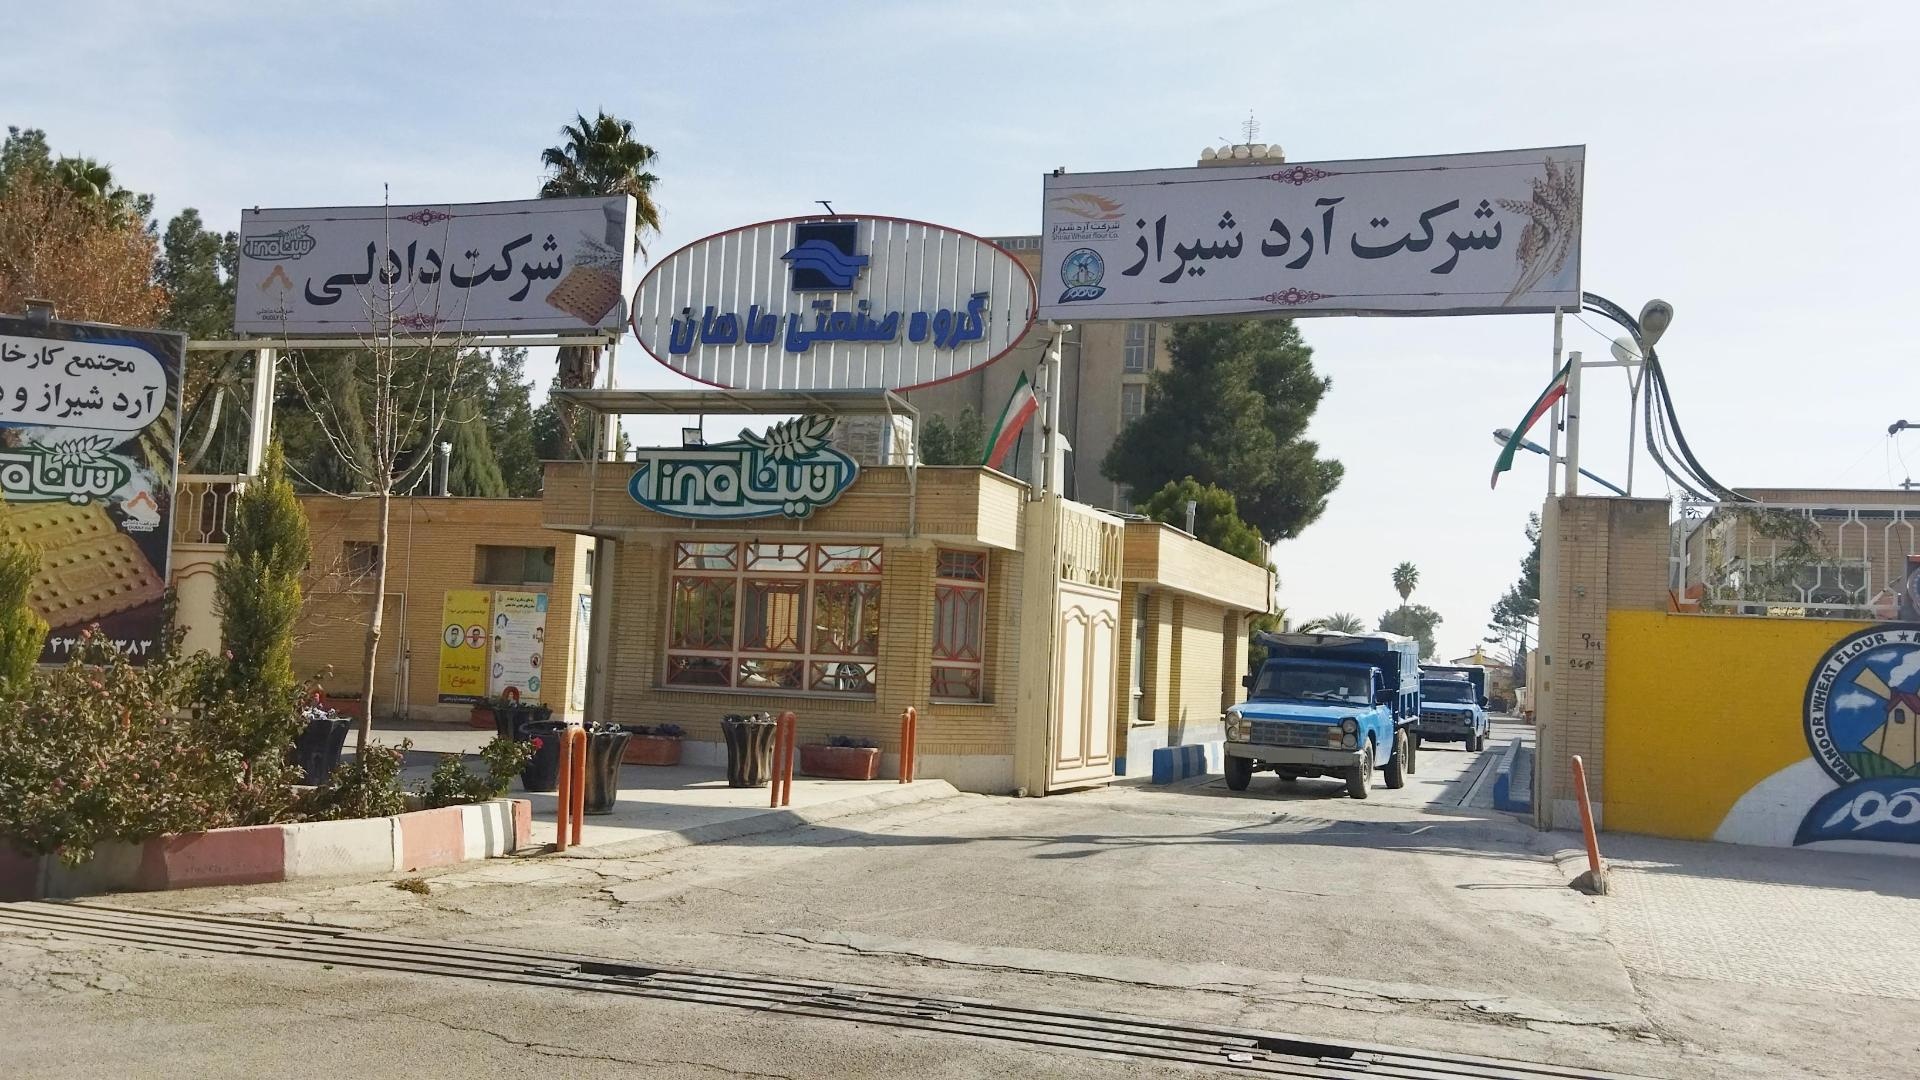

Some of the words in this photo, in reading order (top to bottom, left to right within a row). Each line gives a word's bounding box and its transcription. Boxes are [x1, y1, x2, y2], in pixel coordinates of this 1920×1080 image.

[1053, 224, 1075, 234] شیراز
[1076, 222, 1090, 232] آرد
[1091, 221, 1120, 232] شرکت
[1122, 210, 1242, 284] شیراز
[1261, 196, 1344, 269] آرد
[1351, 199, 1502, 274] شرکت
[304, 239, 442, 305] دادلی
[449, 233, 564, 302] شرکت
[668, 303, 778, 355] ماهان
[785, 299, 900, 353] صنعتی
[908, 291, 991, 350] گروه
[64, 353, 136, 377] مجتمع
[11, 386, 28, 412] و
[35, 383, 104, 417] شیراز
[112, 385, 158, 418] آرد
[32, 453, 116, 504] تینا
[637, 450, 743, 501] Tina
[741, 451, 838, 517] تینا
[1834, 632, 1888, 666] FLOUR
[1813, 665, 1838, 713] WHEAT
[1813, 716, 1856, 782] MAHOOR
